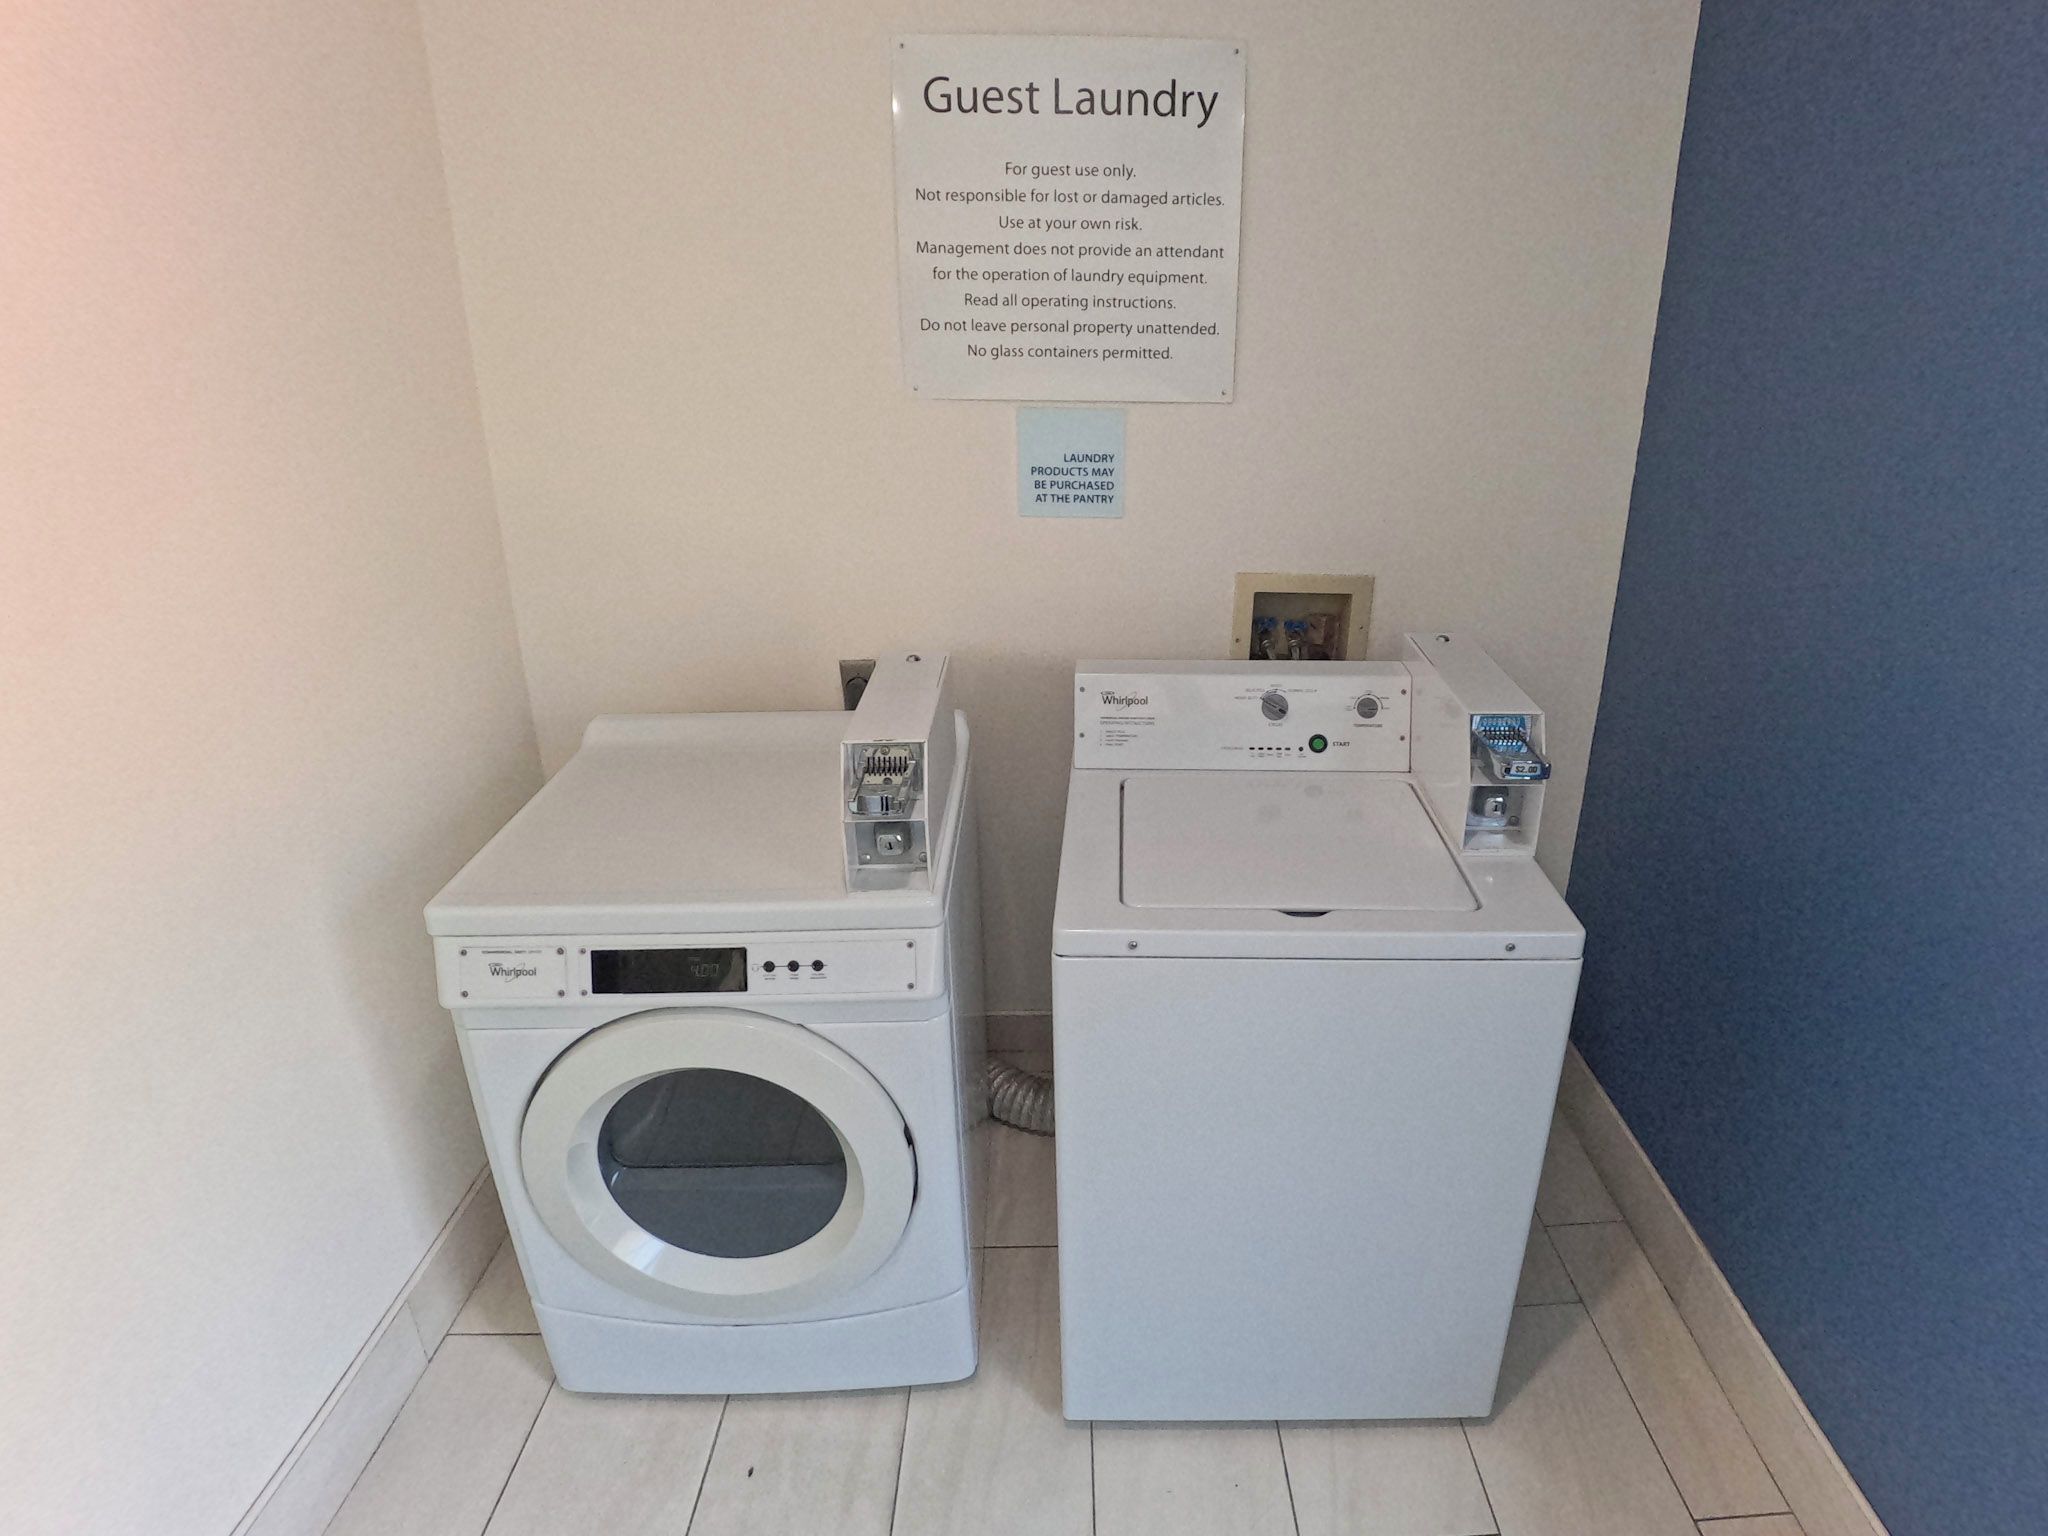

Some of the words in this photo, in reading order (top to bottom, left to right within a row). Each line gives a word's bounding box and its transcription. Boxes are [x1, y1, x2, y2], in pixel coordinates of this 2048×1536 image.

[923, 75, 1041, 115] Guest
[1053, 77, 1220, 130] Laundry
[1005, 161, 1028, 176] For
[1031, 164, 1071, 180] guest
[1074, 166, 1100, 177] use
[1102, 163, 1137, 182] only.
[915, 187, 942, 202] Not
[945, 187, 1027, 205] responsible
[1030, 188, 1050, 203] for
[1053, 188, 1079, 204] lost
[1082, 192, 1098, 204] or
[1100, 189, 1168, 209] damaged
[1171, 191, 1225, 207] articles.
[998, 215, 1025, 230] Use
[1027, 217, 1042, 229] at
[1045, 219, 1078, 233] your
[1079, 219, 1111, 230] own
[1115, 216, 1143, 231] risk.
[916, 240, 1010, 258] Management
[1013, 241, 1047, 256] does
[1050, 243, 1075, 256] not
[1078, 242, 1132, 259] provide
[1134, 246, 1152, 257] an
[1155, 244, 1225, 259] attendant
[932, 265, 952, 281] for
[955, 266, 979, 281] the
[981, 268, 1050, 284] operation
[1053, 267, 1069, 282] of
[1071, 267, 1125, 287] laundry
[1127, 270, 1208, 287] equipment.
[964, 292, 999, 307] Read
[1001, 293, 1018, 307] all
[1021, 293, 1089, 312] operating
[1092, 294, 1177, 310] instructions.
[920, 317, 941, 332] Do
[943, 320, 968, 332] not
[971, 317, 1007, 333] leave
[1010, 319, 1069, 336] personal
[1072, 322, 1134, 339] property
[1136, 321, 1220, 336] unattended.
[967, 343, 987, 357] No
[990, 343, 1024, 361] glass
[1027, 344, 1099, 359] containers
[1102, 346, 1173, 362] permitted.
[1063, 453, 1115, 463] LAUNDRY
[1030, 466, 1089, 476] PRODUCTS
[1091, 467, 1115, 476] MAY
[1034, 479, 1047, 489] BE
[1049, 480, 1115, 490] PURCHASED
[1035, 493, 1048, 502] AT
[1049, 493, 1071, 503] THE
[1073, 494, 1114, 503] PANTRY
[1102, 695, 1149, 708] Whirlpool
[489, 966, 537, 978] Whirlpool
